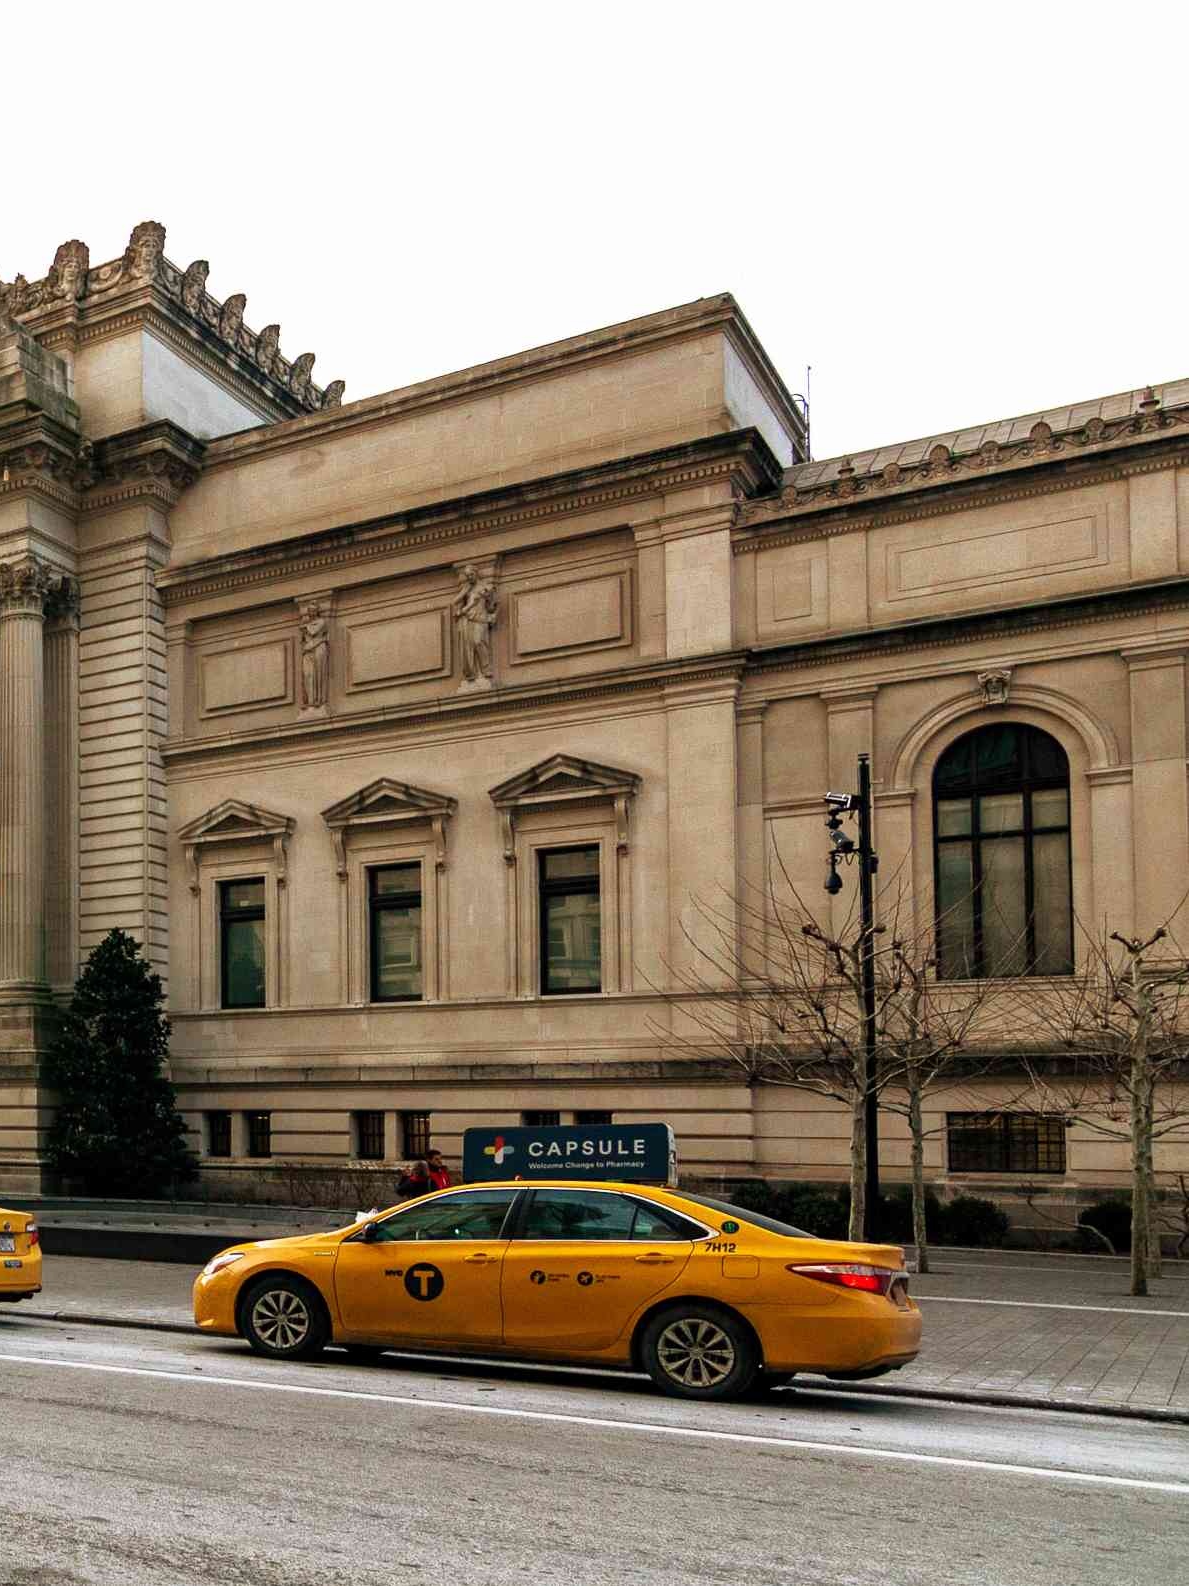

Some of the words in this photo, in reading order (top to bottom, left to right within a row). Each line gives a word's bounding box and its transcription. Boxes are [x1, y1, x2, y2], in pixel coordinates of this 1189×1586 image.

[528, 1139, 645, 1157] CAPSULE
[565, 1161, 594, 1170] Change
[596, 1160, 604, 1168] to
[606, 1159, 645, 1169] Pharmacy
[705, 1242, 737, 1253] 7H12
[413, 1270, 435, 1297] T
